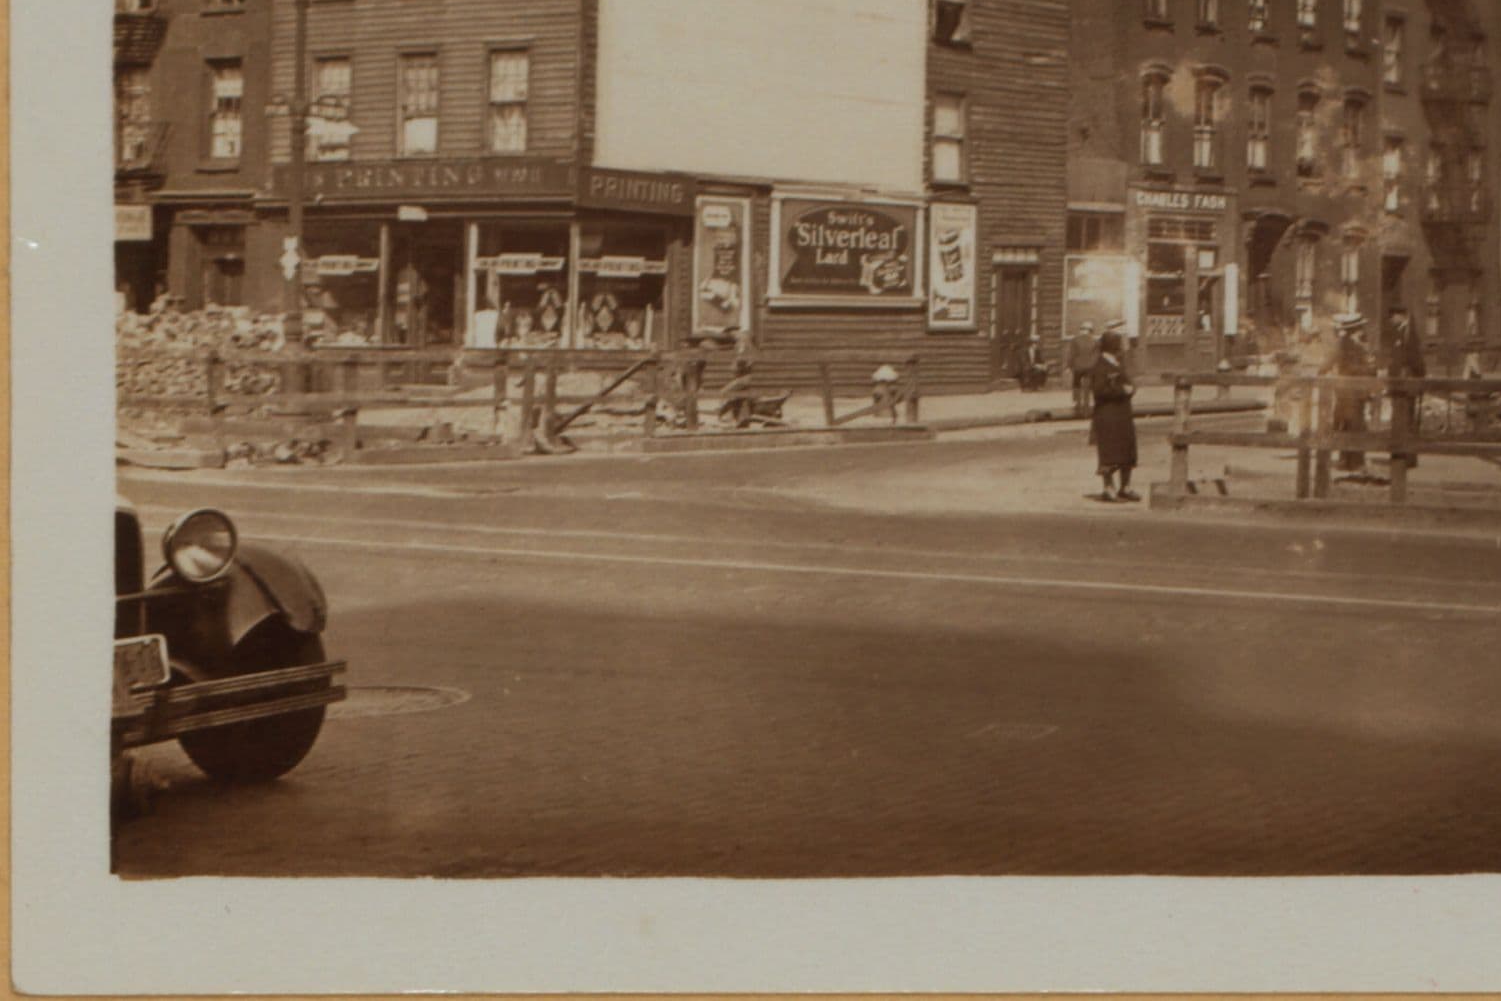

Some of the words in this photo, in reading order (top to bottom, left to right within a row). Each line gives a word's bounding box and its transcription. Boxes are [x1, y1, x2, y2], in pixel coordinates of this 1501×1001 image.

[335, 166, 485, 189] PRINTING
[590, 175, 683, 204] PRINTING
[794, 221, 905, 250] Silverleaf
[815, 247, 849, 265] Lard
